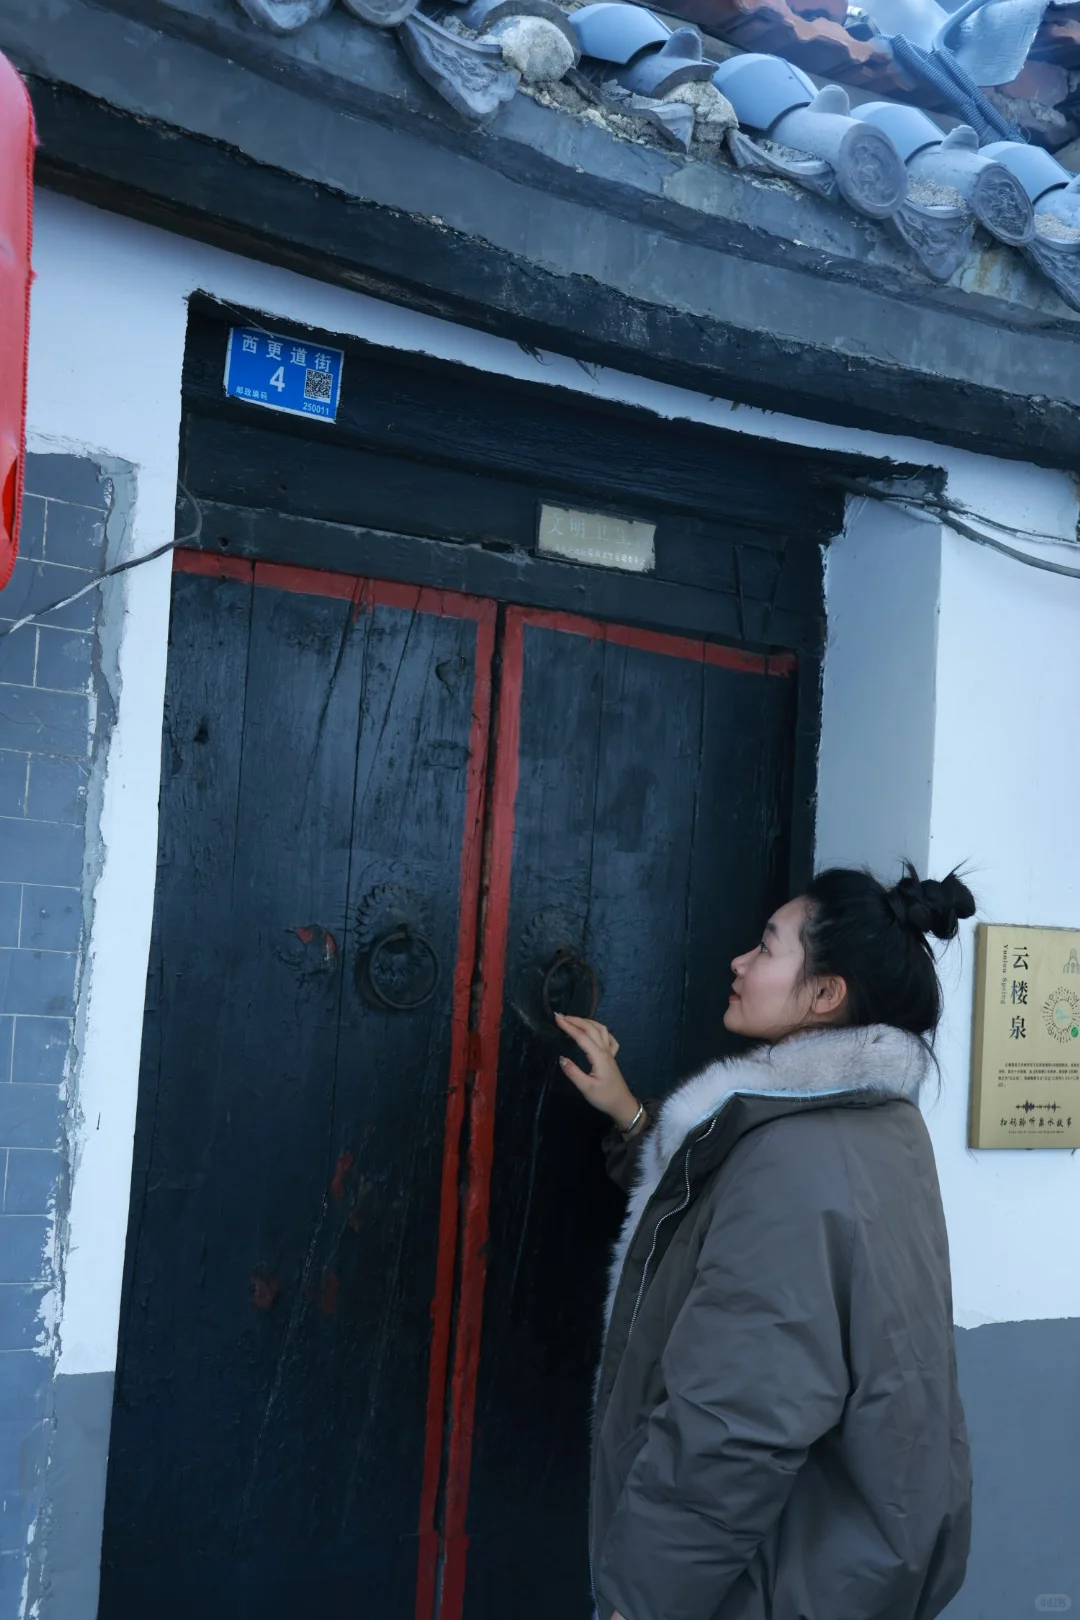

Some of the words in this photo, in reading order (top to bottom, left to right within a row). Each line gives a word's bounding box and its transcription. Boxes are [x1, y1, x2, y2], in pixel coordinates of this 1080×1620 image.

[242, 334, 332, 373] 西更道街
[269, 366, 286, 392] 4
[235, 386, 268, 401] 邮政编码
[302, 401, 330, 415] 250011
[1008, 946, 1030, 1040] 云楼泉
